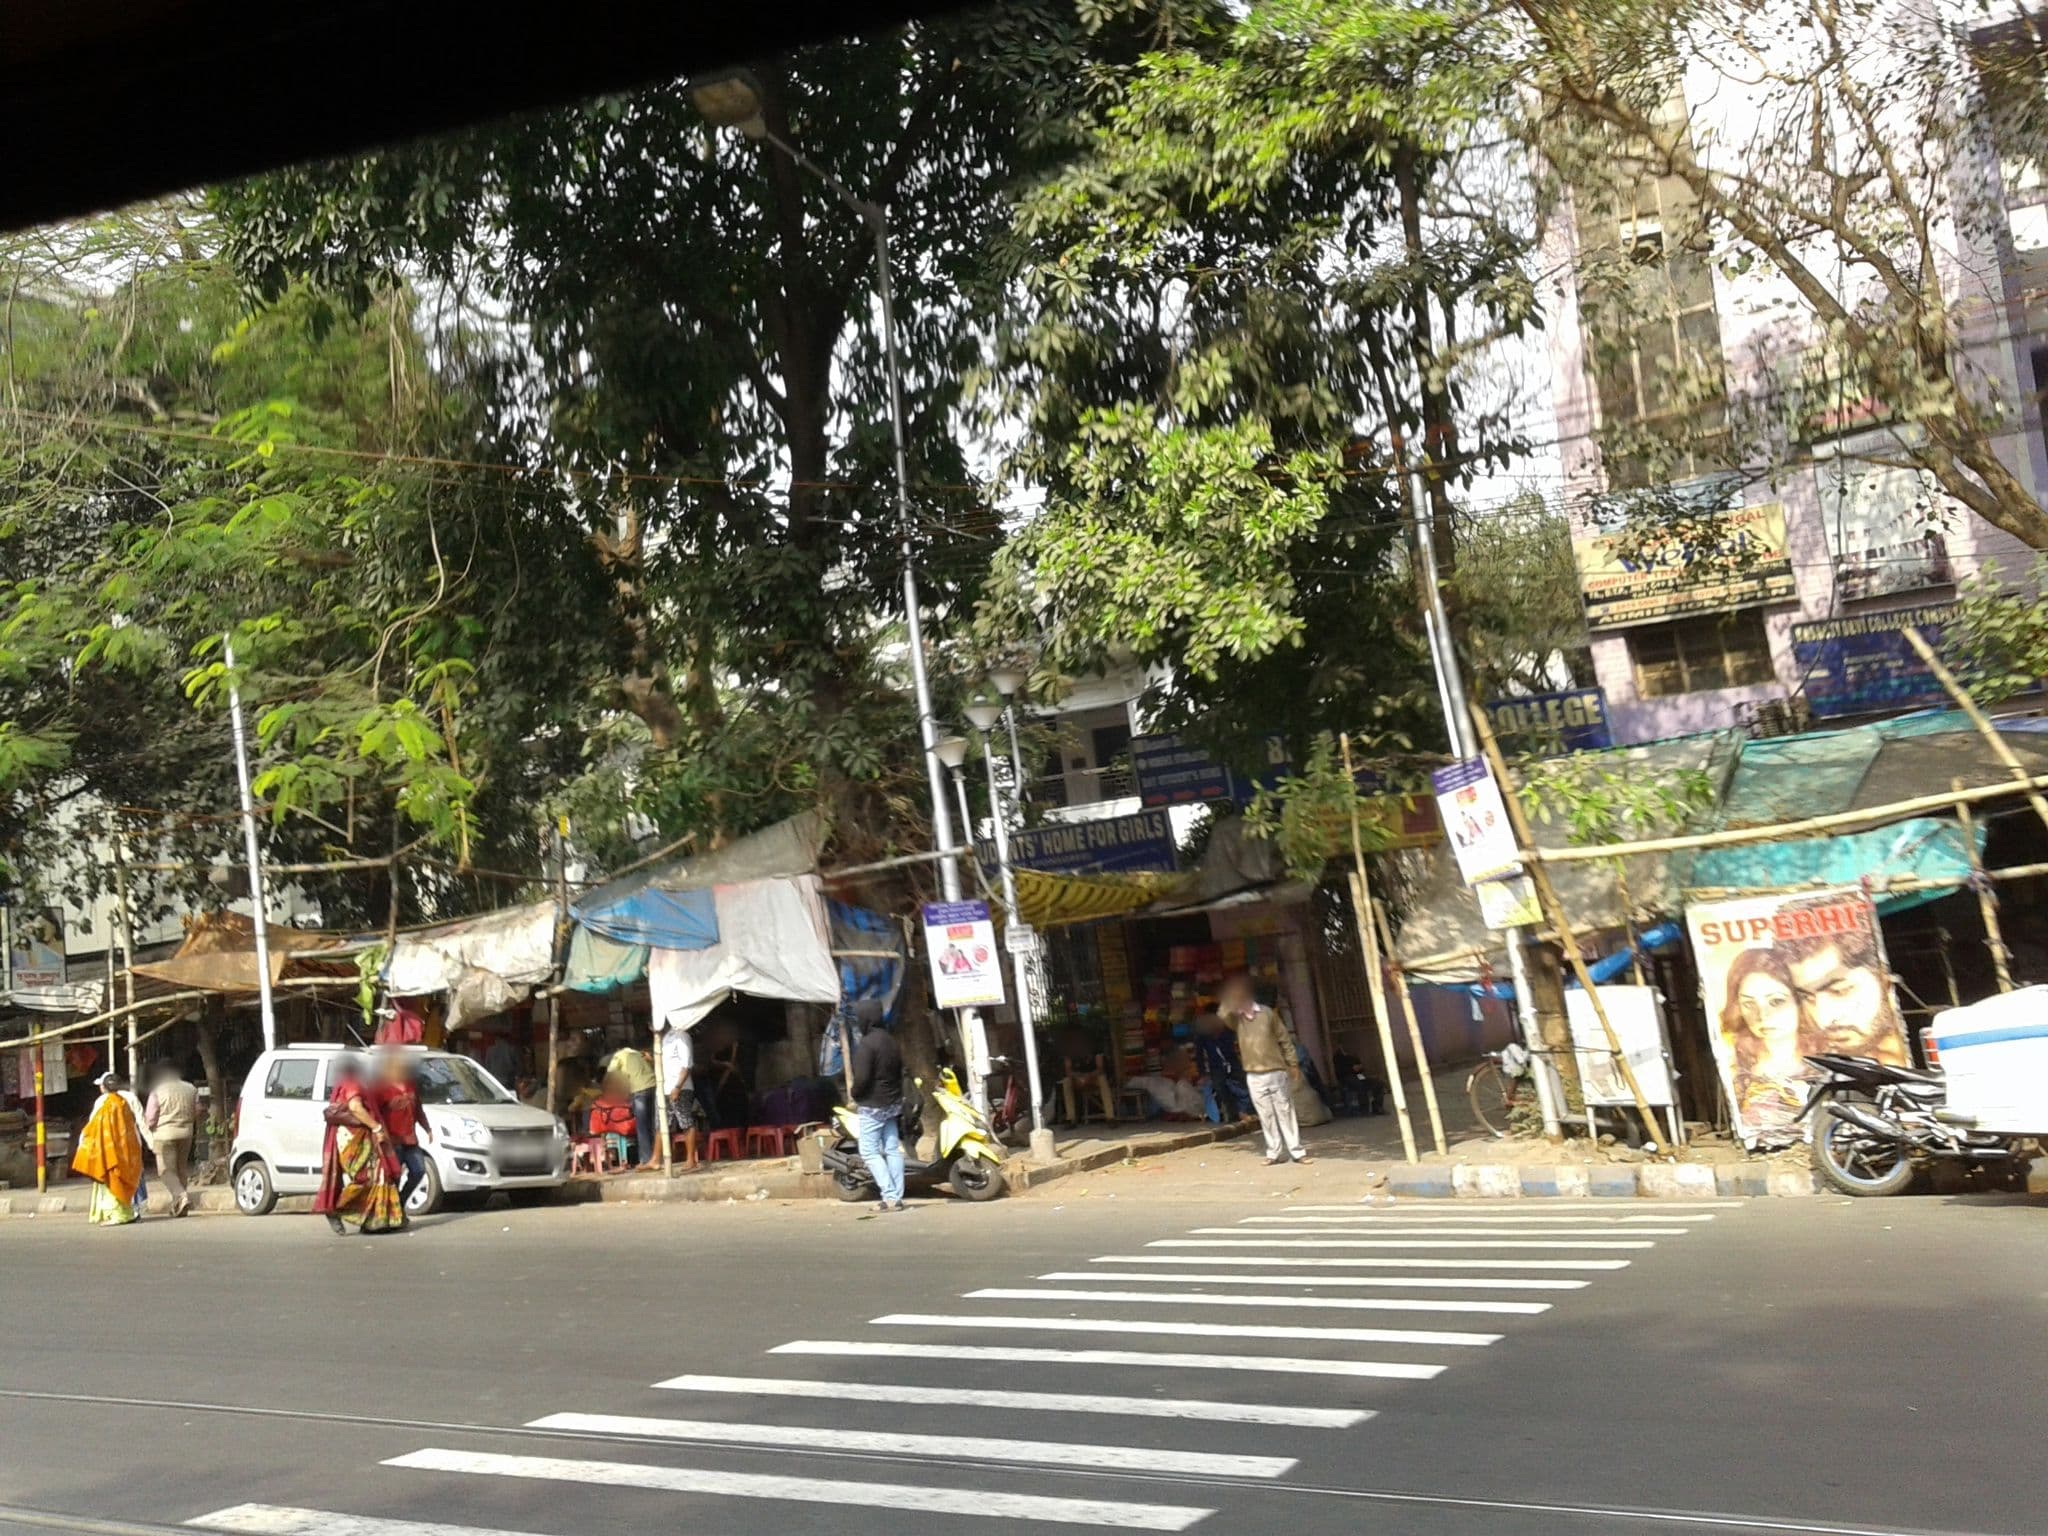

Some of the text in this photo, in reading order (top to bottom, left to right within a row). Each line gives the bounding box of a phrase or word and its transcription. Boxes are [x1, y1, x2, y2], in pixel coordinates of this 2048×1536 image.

[1587, 573, 1649, 589] COMPUTER
[1491, 693, 1603, 732] OLLEGE
[1041, 829, 1087, 856] HOME
[1088, 820, 1118, 848] FOR
[1119, 813, 1166, 842] GIRLS
